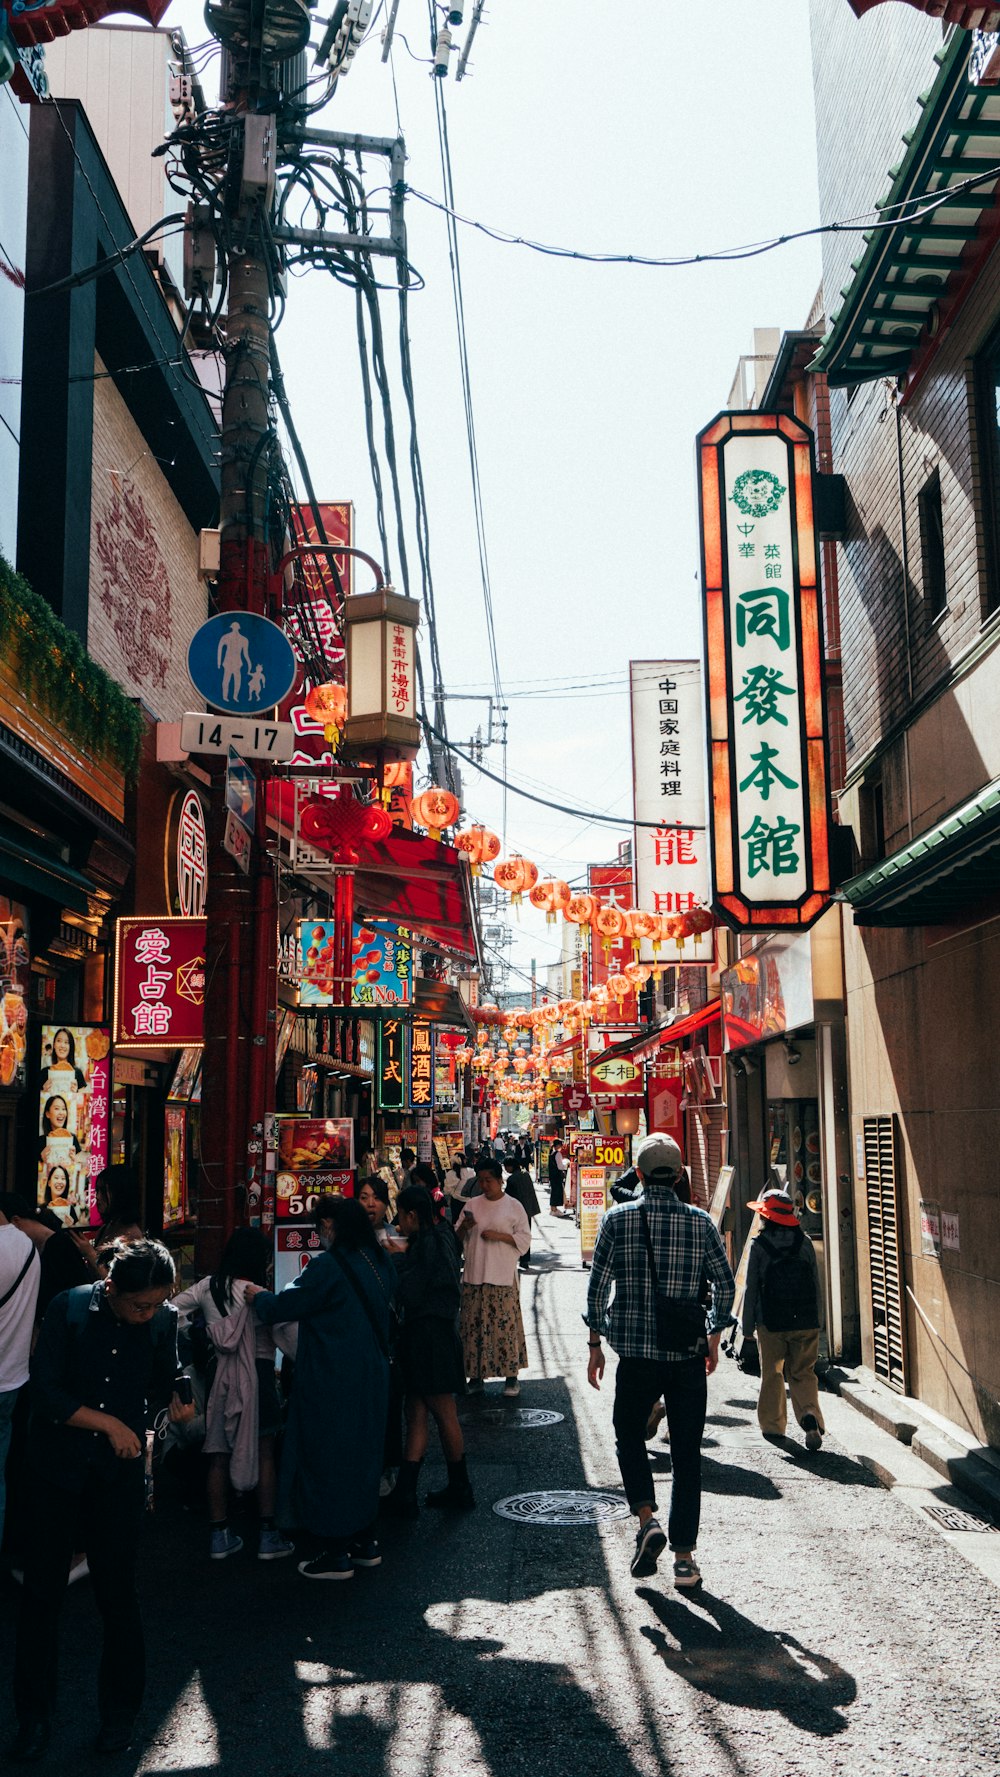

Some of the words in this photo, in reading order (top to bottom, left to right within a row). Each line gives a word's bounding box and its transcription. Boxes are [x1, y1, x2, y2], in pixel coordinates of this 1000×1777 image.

[736, 522, 756, 559] 中華
[762, 543, 782, 580] 菜館
[391, 625, 410, 713] 中華街市場通り
[199, 722, 279, 752] 14-17
[658, 678, 683, 797] 中国家庭料理
[732, 587, 800, 879] 同發本館
[132, 928, 174, 1036] 愛占館
[411, 1015, 431, 1104] 鳳酒家
[597, 1064, 635, 1080] 手相
[595, 1147, 624, 1164] 500
[299, 1174, 351, 1186] キャンペーン
[286, 1230, 321, 1249] 愛占
